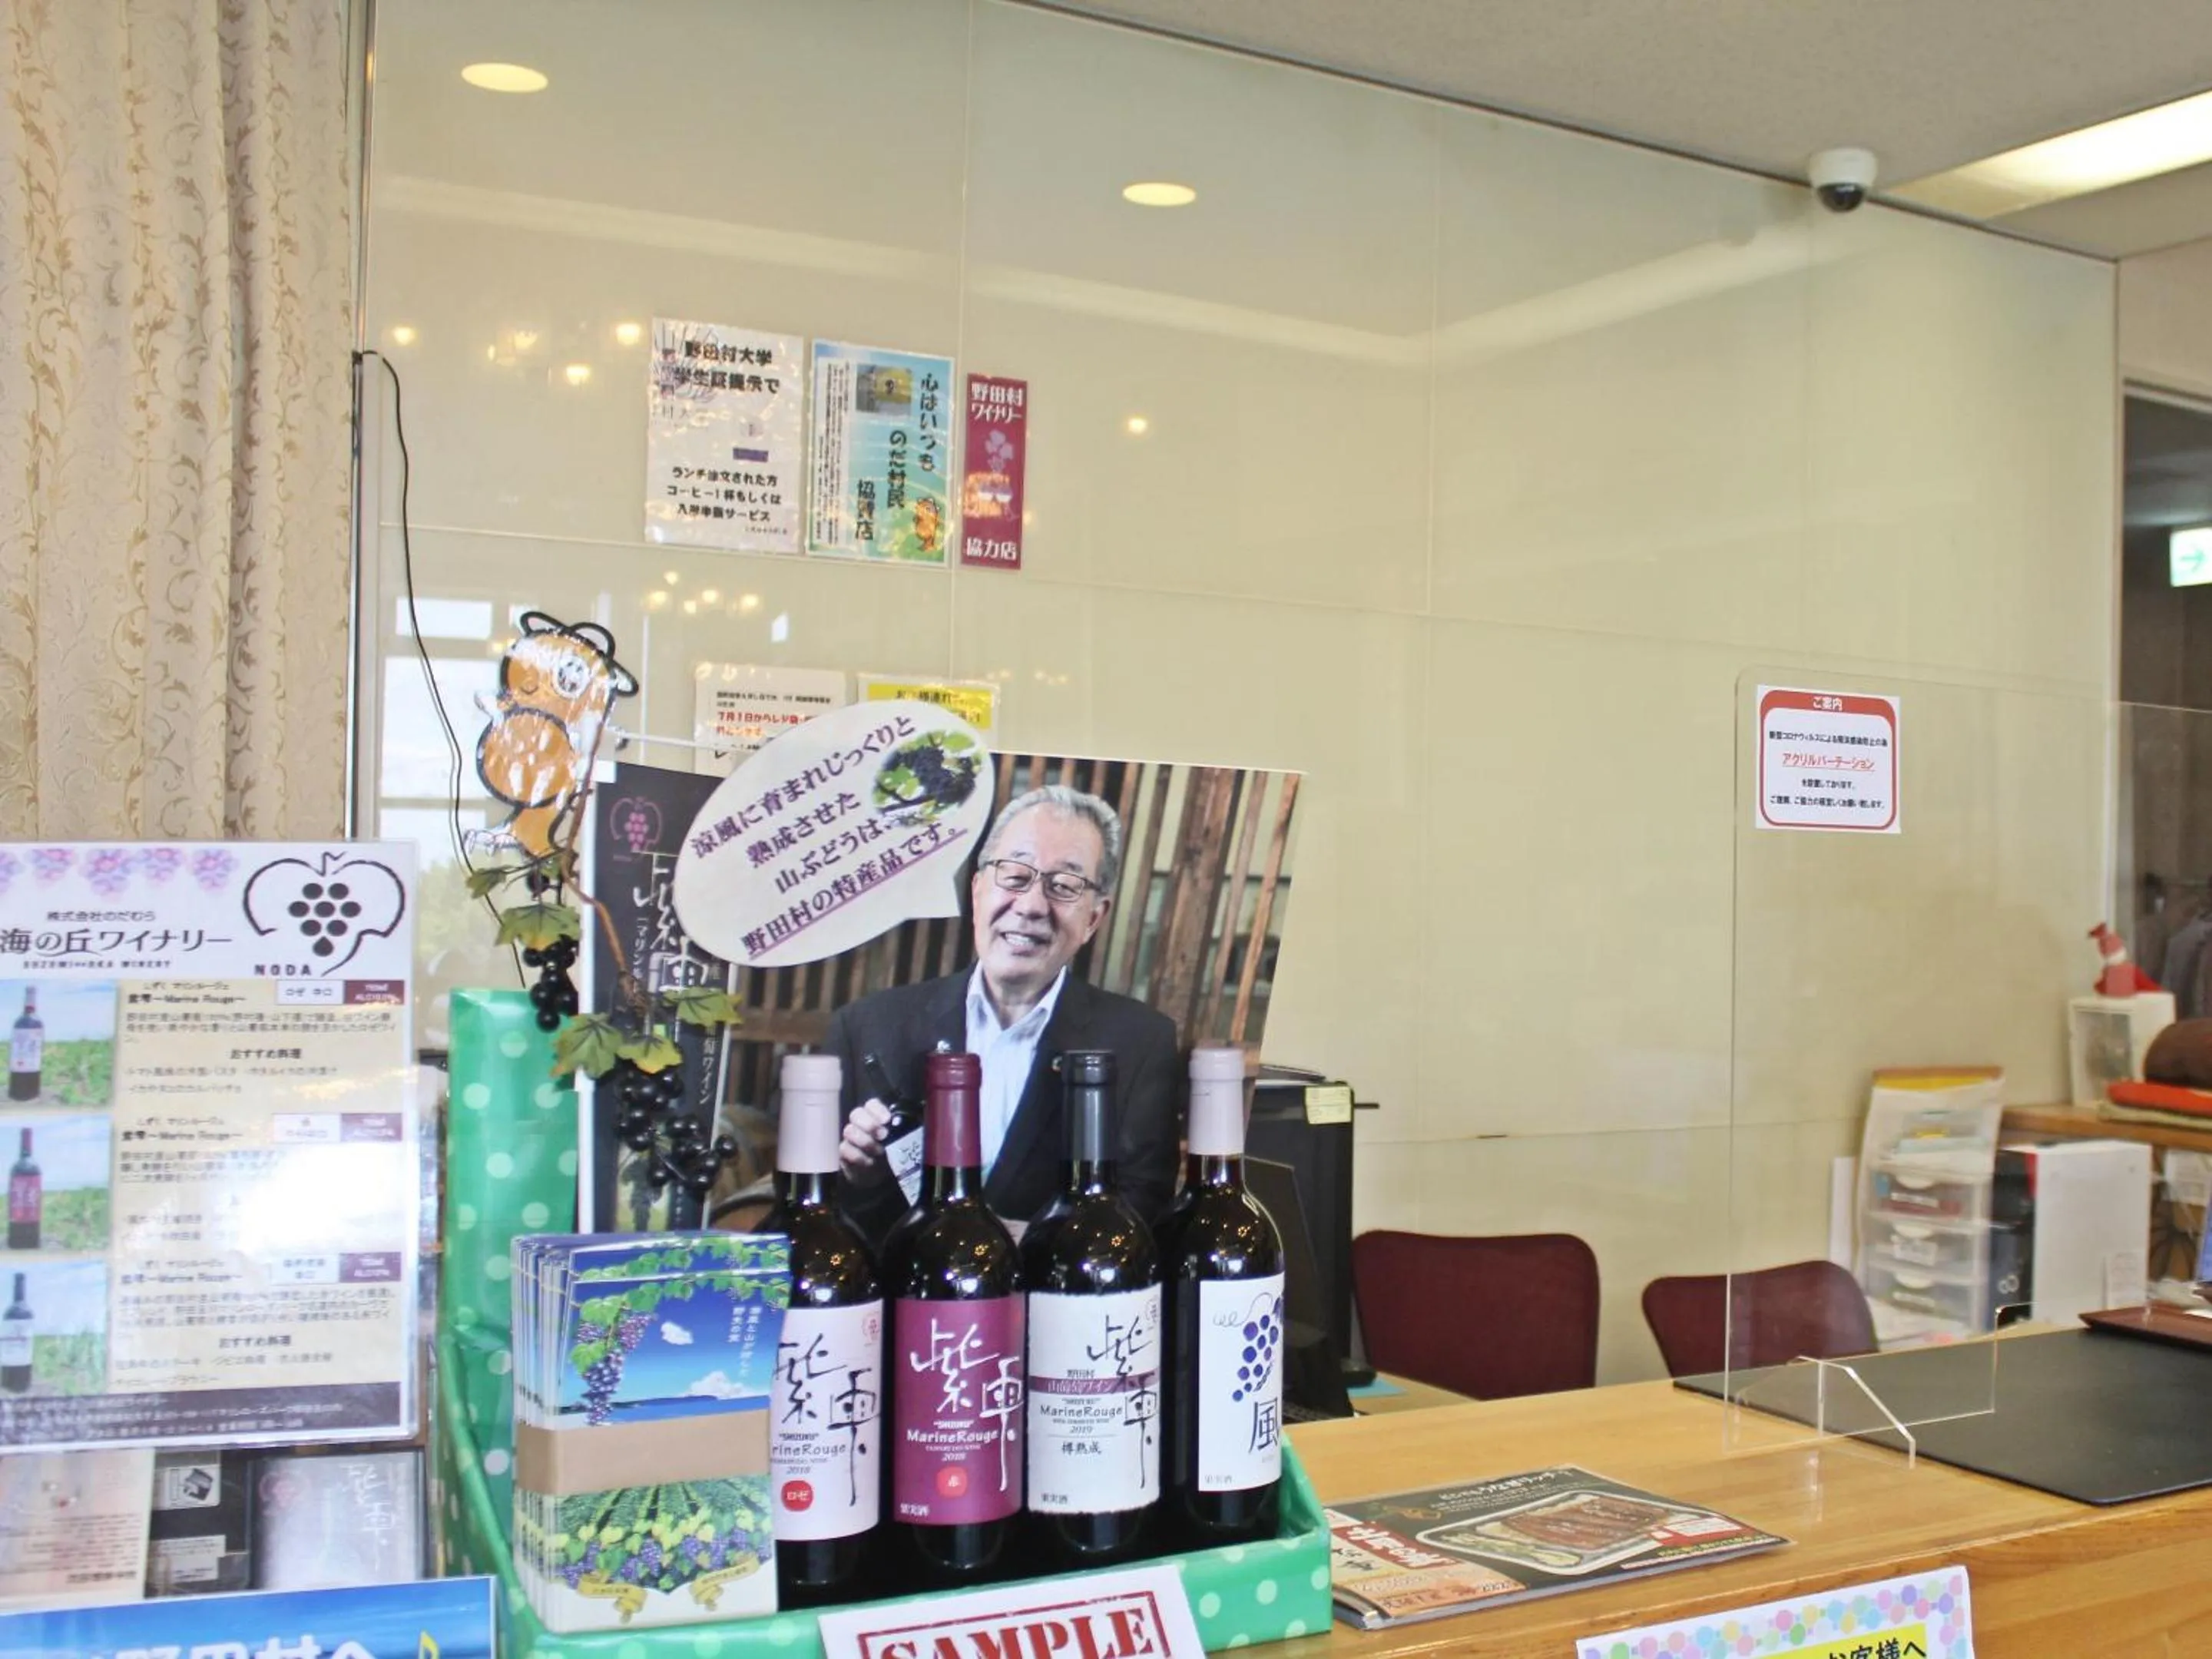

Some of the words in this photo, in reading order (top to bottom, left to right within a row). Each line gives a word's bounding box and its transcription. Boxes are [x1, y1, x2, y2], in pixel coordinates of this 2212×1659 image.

[971, 382, 1024, 406] 野田村
[919, 373, 940, 472] 心はいつも
[971, 404, 1023, 424] ワイナリー
[965, 537, 1018, 561] 協力店
[1812, 696, 1843, 711] ご案内
[690, 714, 917, 859] 涼風に育まれじっくりと
[746, 790, 861, 869] 熟成させた
[740, 821, 959, 957] 野田村の特産品です。
[254, 964, 312, 976] NODA
[1039, 1405, 1123, 1419] MarineRouge
[906, 1429, 999, 1444] MarineRouge
[771, 1443, 846, 1458] rineRouge
[1061, 1441, 1103, 1455] 樽熟成
[1829, 1637, 1927, 1659] 客様へ
